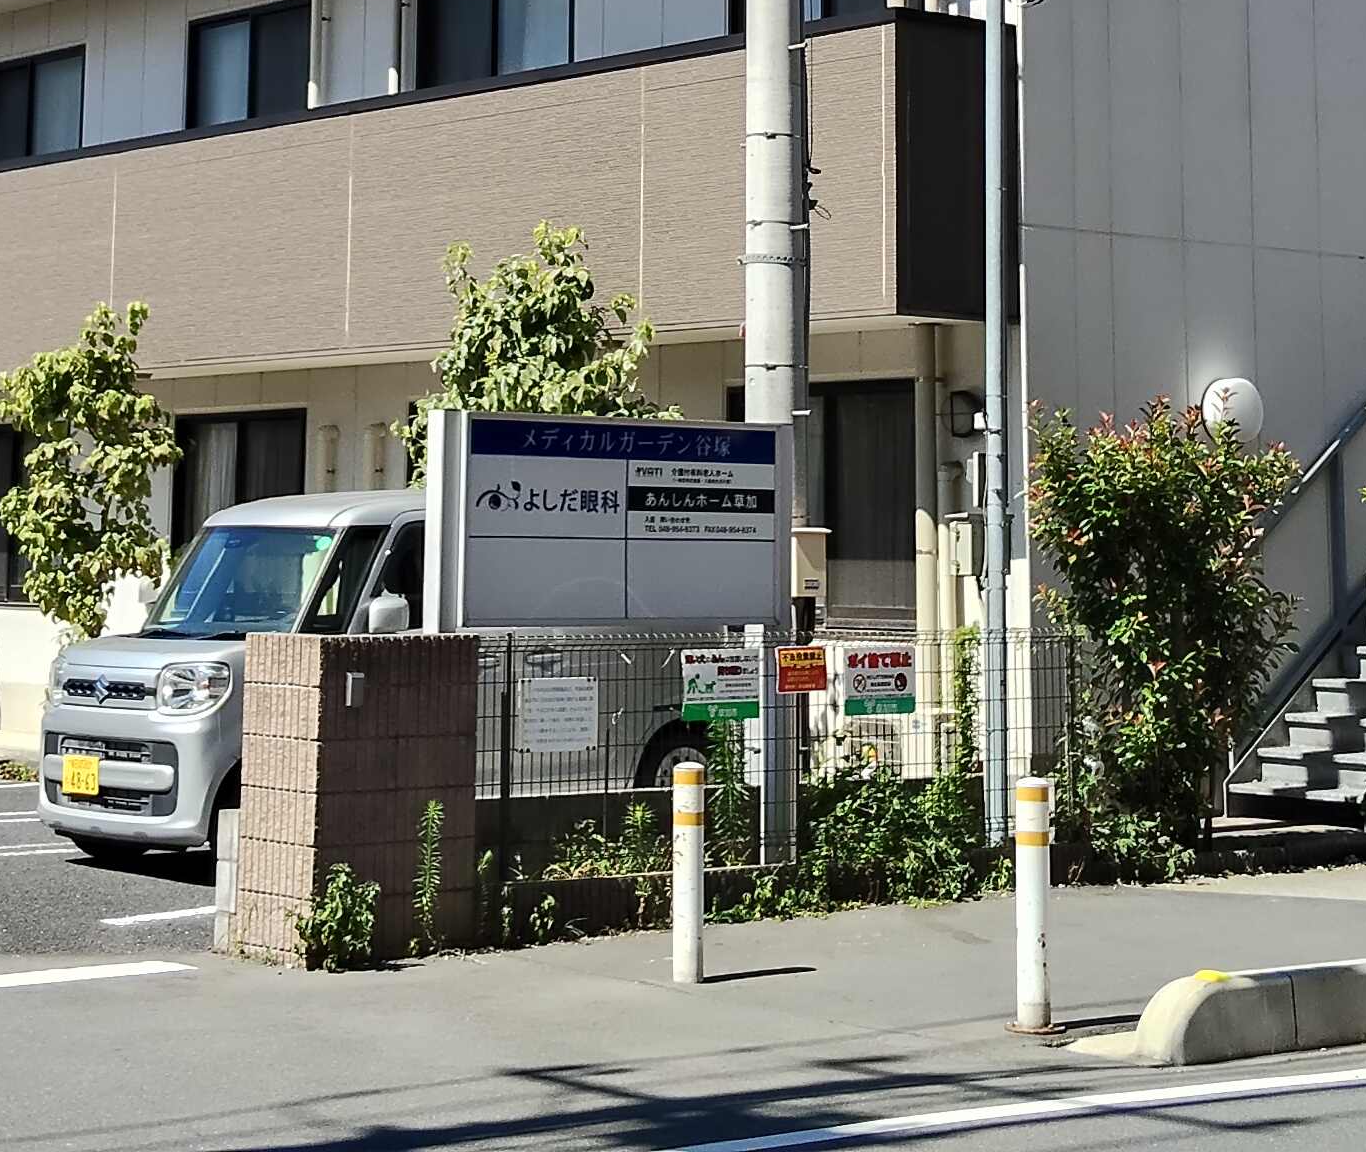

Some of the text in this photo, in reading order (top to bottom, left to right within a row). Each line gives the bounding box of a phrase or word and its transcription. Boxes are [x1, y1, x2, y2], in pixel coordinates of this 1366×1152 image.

[521, 428, 731, 457] メディカルガーデン谷塚
[523, 488, 621, 515] よしだ眼科
[645, 492, 757, 508] あんしんホーム草加
[847, 651, 912, 668] ポイ捨て禁止
